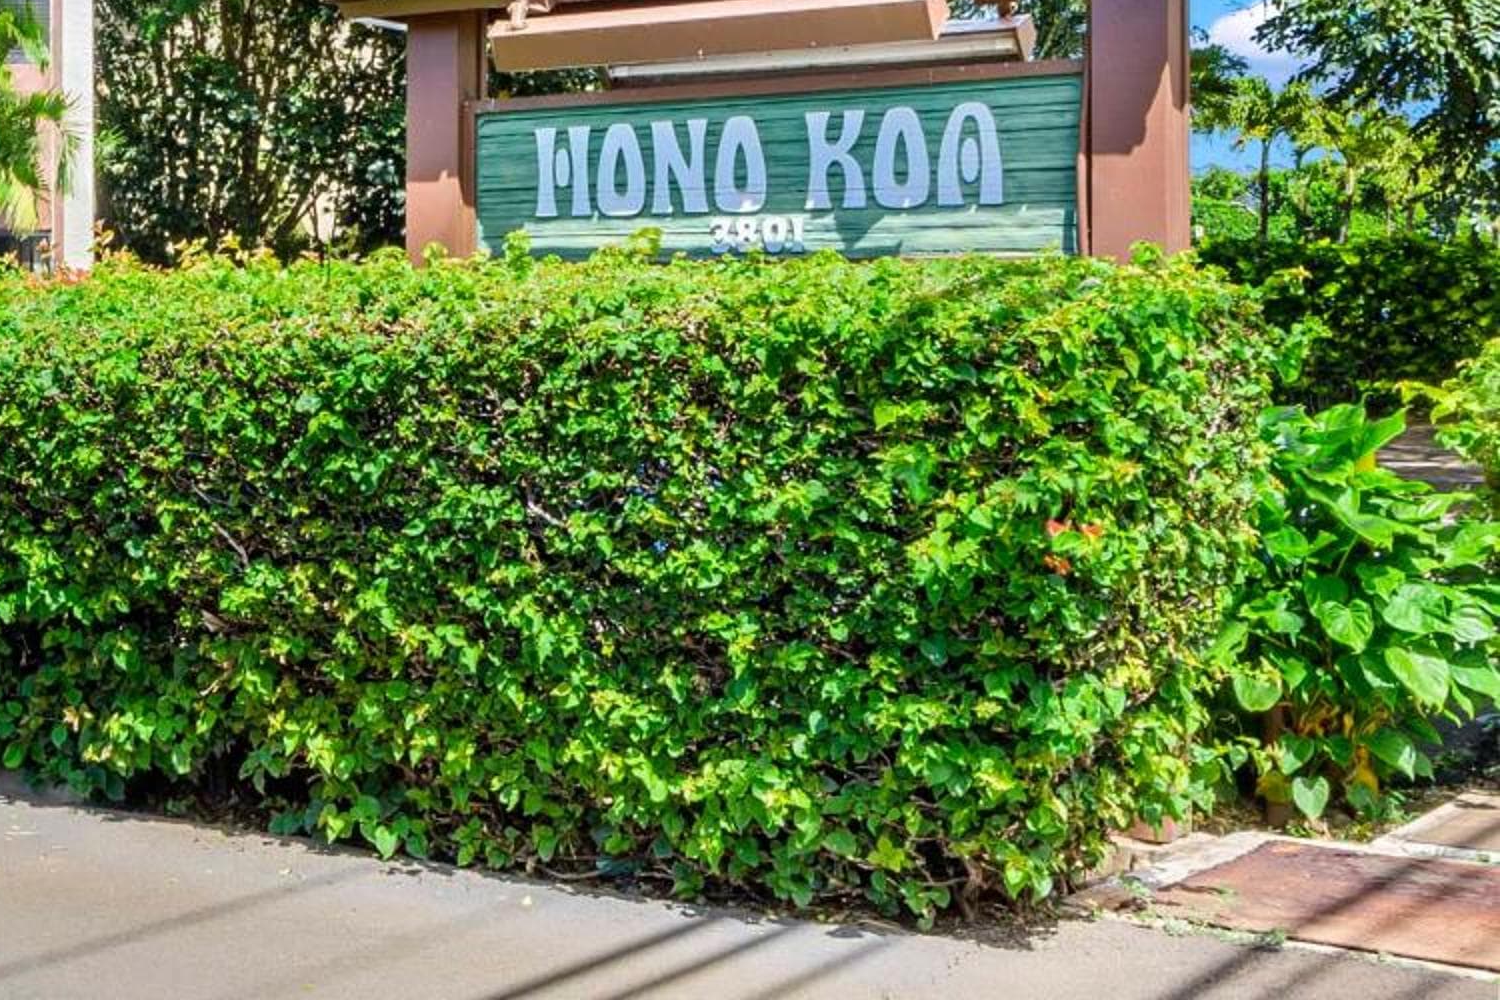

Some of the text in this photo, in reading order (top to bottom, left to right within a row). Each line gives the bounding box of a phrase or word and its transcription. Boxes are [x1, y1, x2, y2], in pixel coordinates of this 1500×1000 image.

[535, 102, 1003, 217] HONO KOA
[709, 217, 804, 253] 3801
